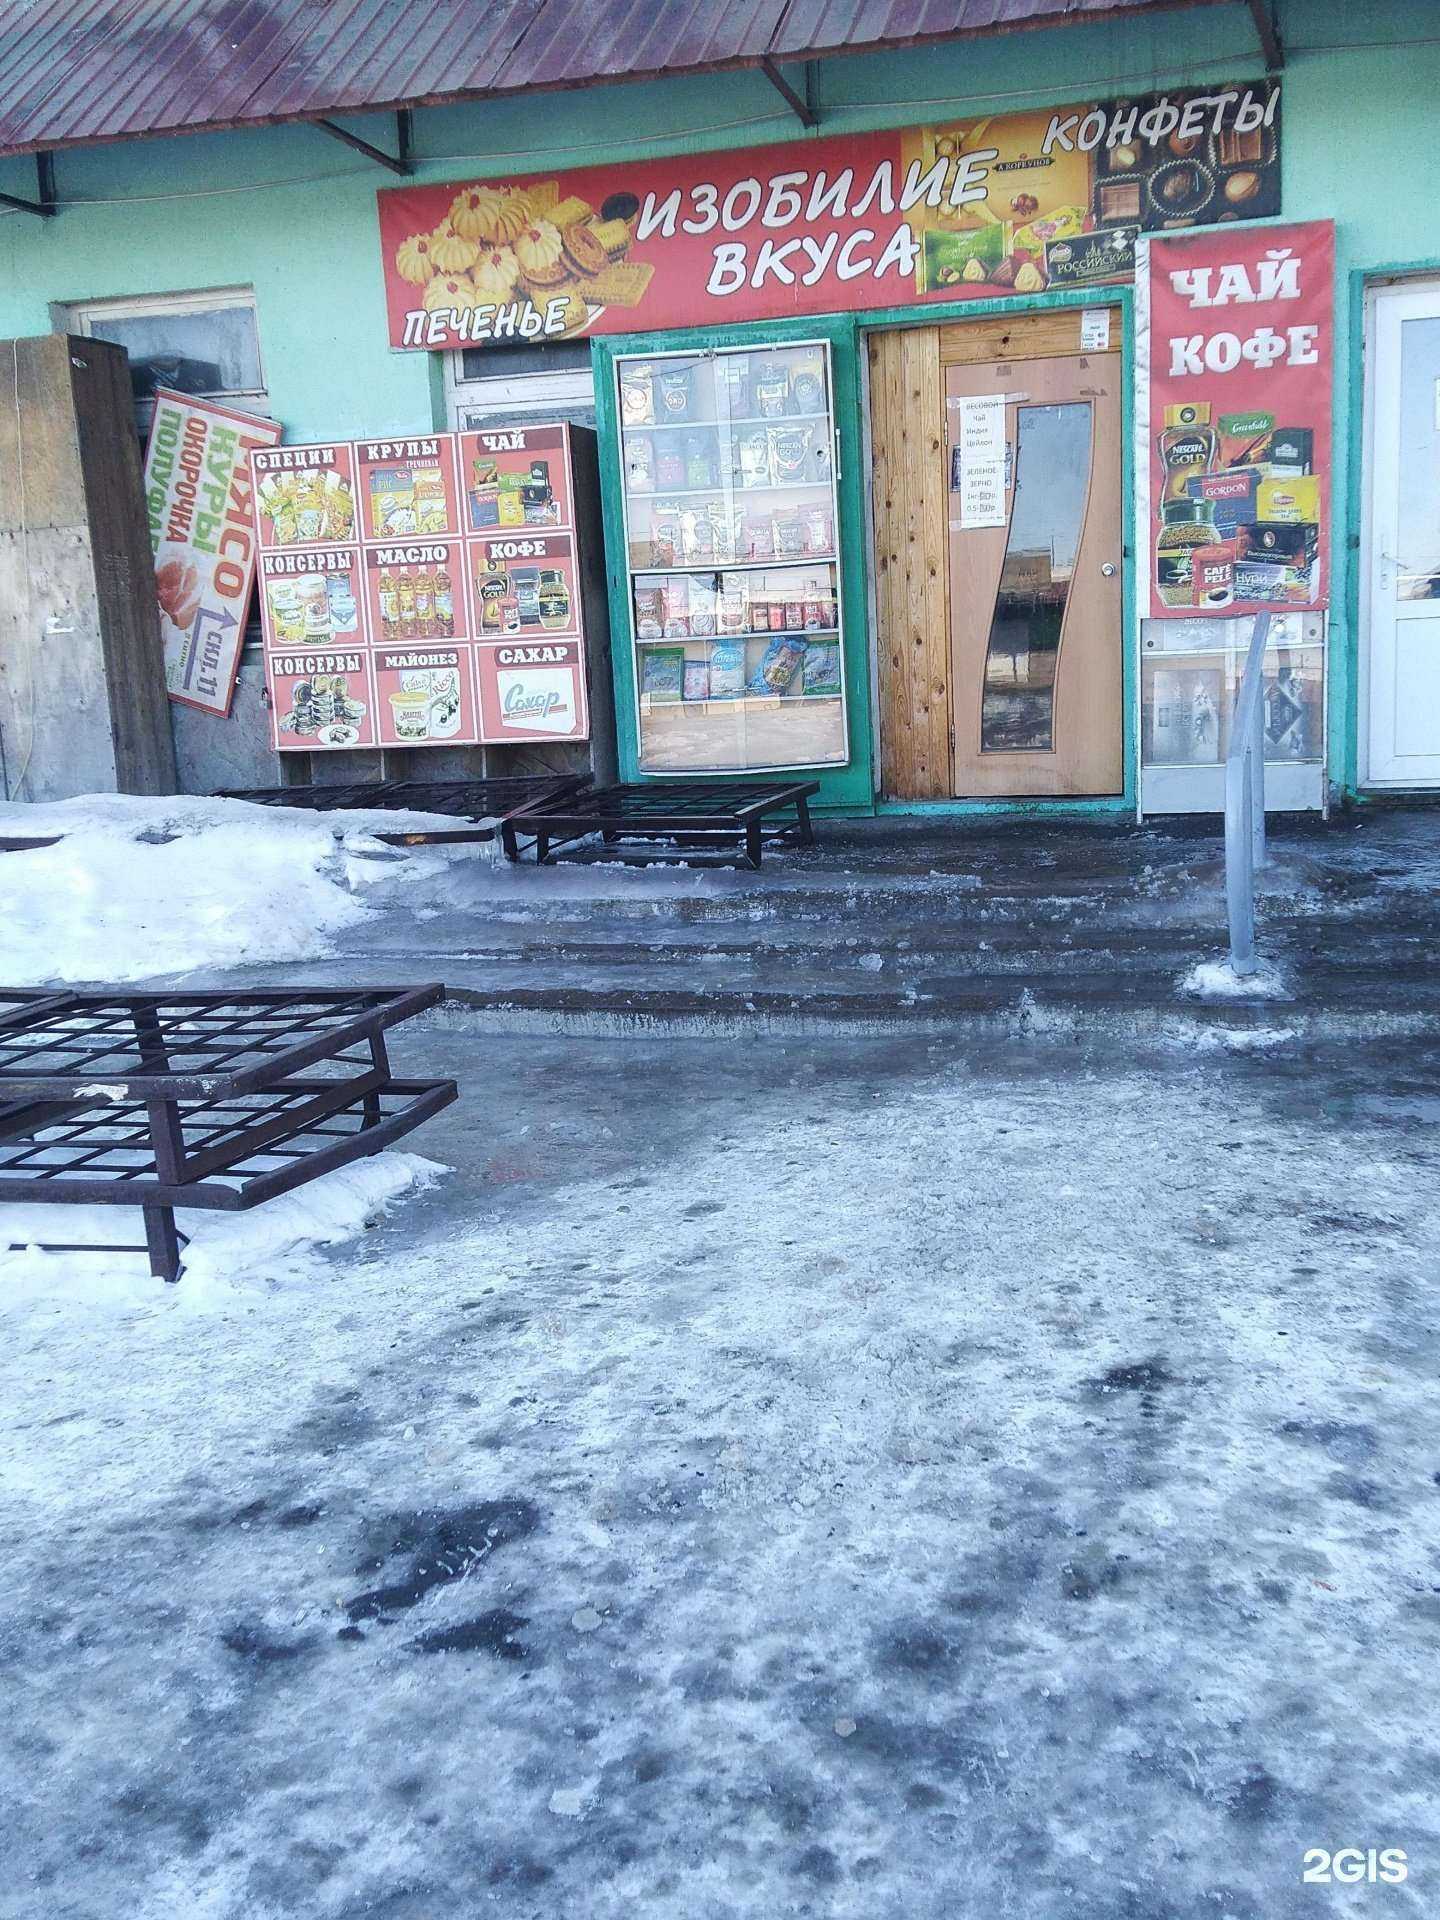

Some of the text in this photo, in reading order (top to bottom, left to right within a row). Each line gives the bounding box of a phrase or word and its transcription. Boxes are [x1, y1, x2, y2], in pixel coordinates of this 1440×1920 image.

[1042, 86, 1280, 154] КОНФЕТЫ
[635, 148, 999, 241] ИЗОБИЛИЕ
[706, 223, 921, 296] ВКУСА
[1169, 248, 1301, 308] ЧАЙ
[402, 298, 570, 346] ПЕЧЕНЬЕ
[1169, 325, 1319, 378] КОФЕ
[366, 440, 438, 460] КРУПЫ
[482, 430, 526, 451] ЧАЙ
[256, 448, 335, 470] СПЕЦИИ
[1169, 454, 1206, 465] GOLD
[165, 417, 208, 543] ОКОРОЧКА
[191, 422, 237, 554] КУРЫ
[1205, 482, 1247, 497] GORDON
[376, 547, 447, 565] МАСЛО
[490, 541, 546, 559] КОФЕ
[264, 552, 352, 574] КОНСЕРВЫ
[273, 653, 360, 675] КОНСЕРВЫ
[385, 652, 458, 668] МАЙОНЕЗ
[499, 646, 568, 664] САХАР
[504, 683, 560, 718] Сахар
